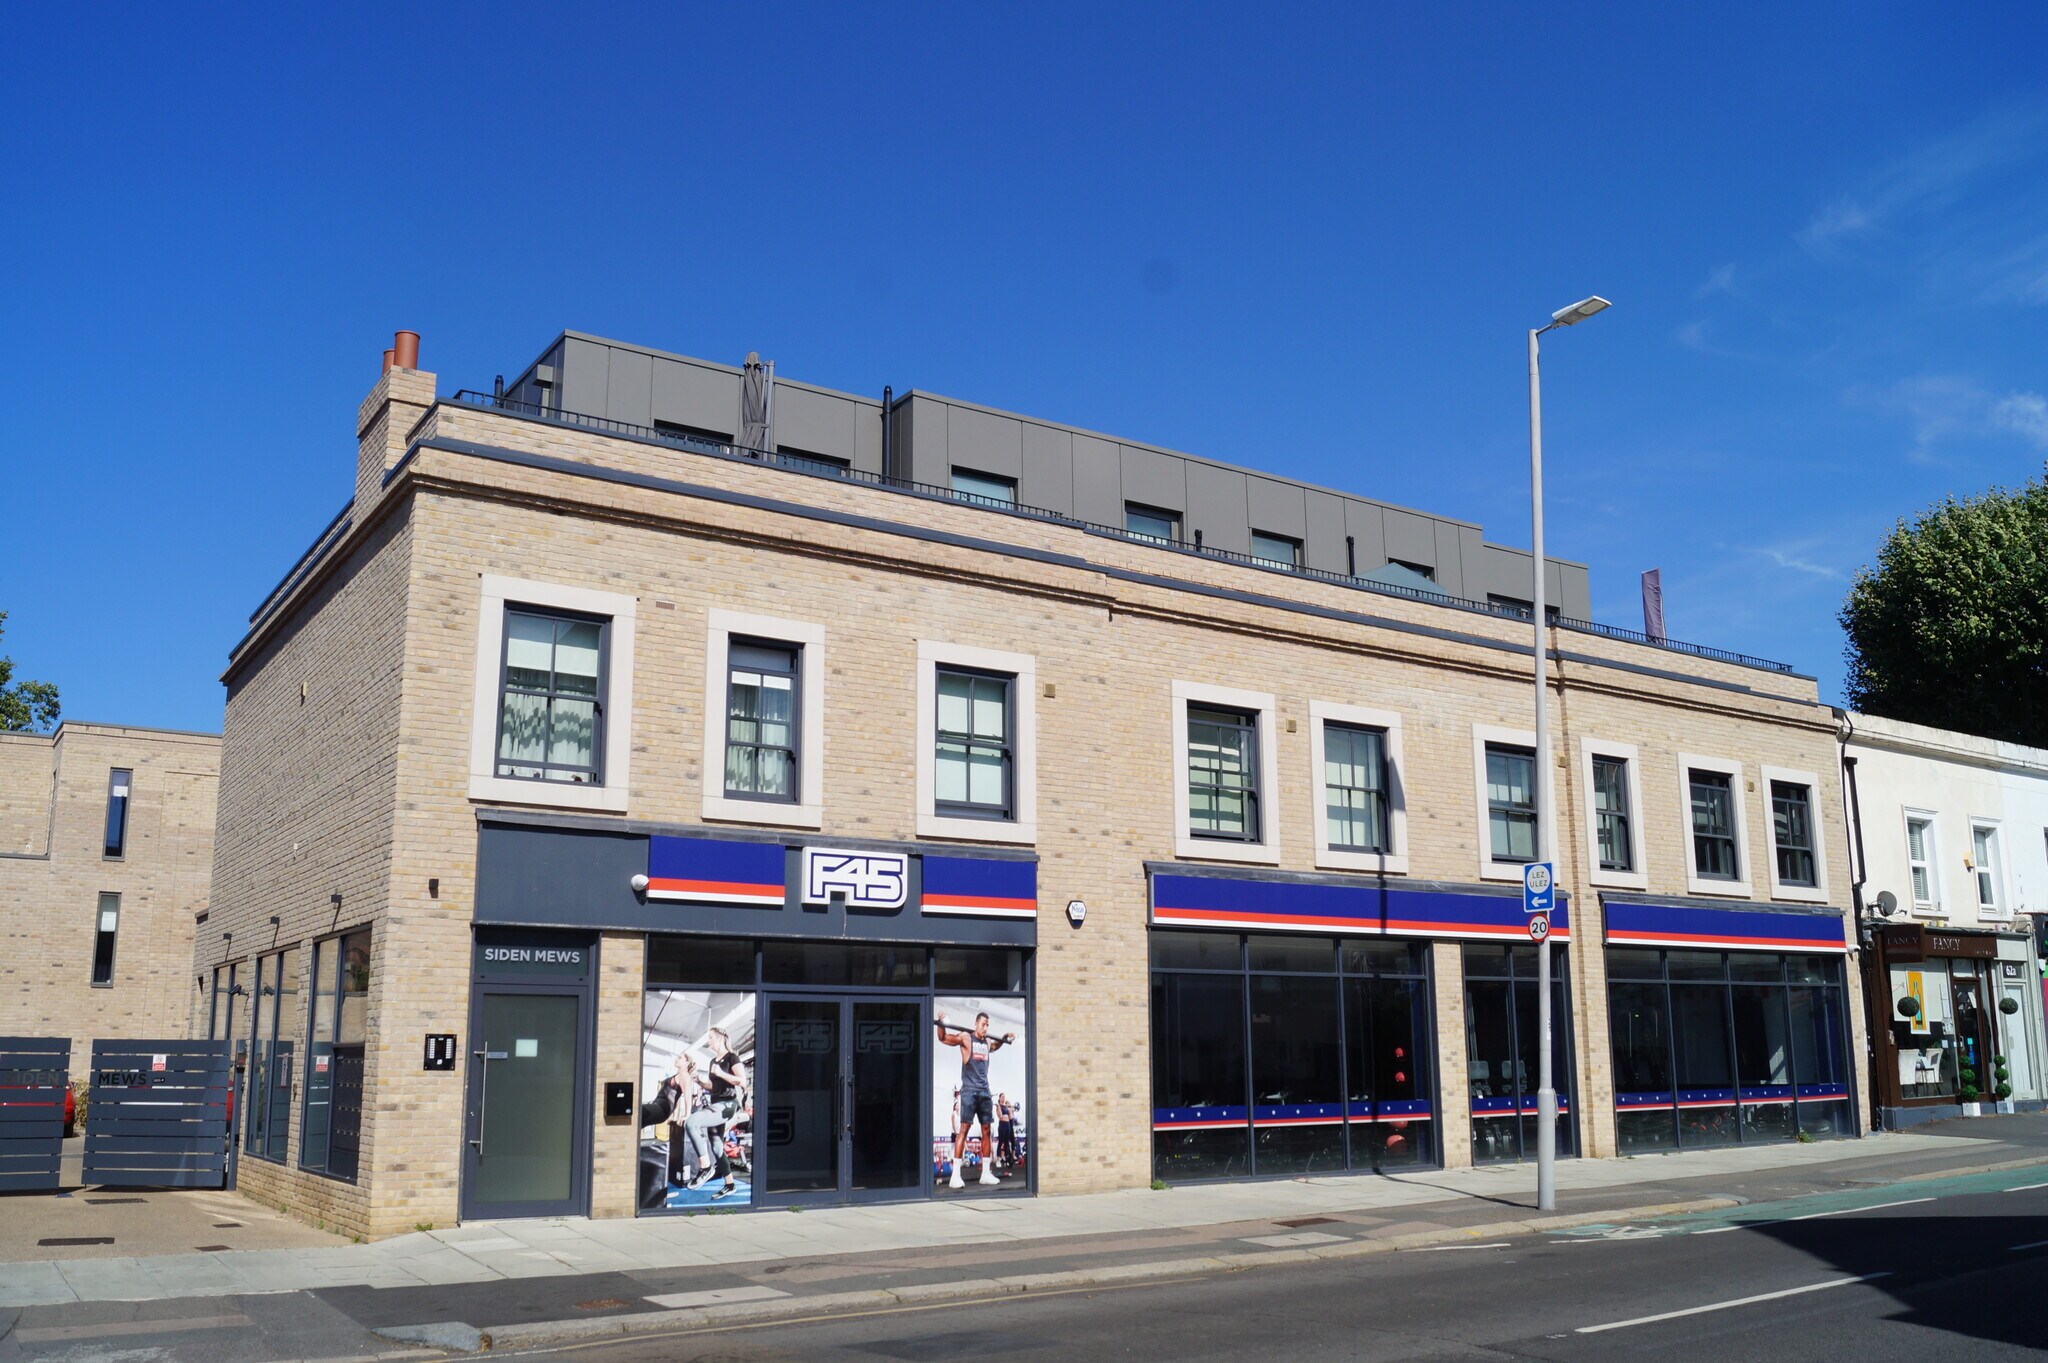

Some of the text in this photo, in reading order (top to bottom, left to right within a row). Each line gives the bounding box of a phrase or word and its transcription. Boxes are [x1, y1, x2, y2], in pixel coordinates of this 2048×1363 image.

[809, 852, 904, 903] F45
[1530, 879, 1548, 887] ULEZ
[1531, 921, 1547, 933] 20
[1932, 937, 1961, 951] FANCY
[484, 948, 580, 963] SIDEN MEWS
[774, 1020, 833, 1052] F45
[857, 1022, 913, 1052] F45
[5, 1072, 60, 1085] IDEN
[98, 1072, 147, 1085] MEWS
